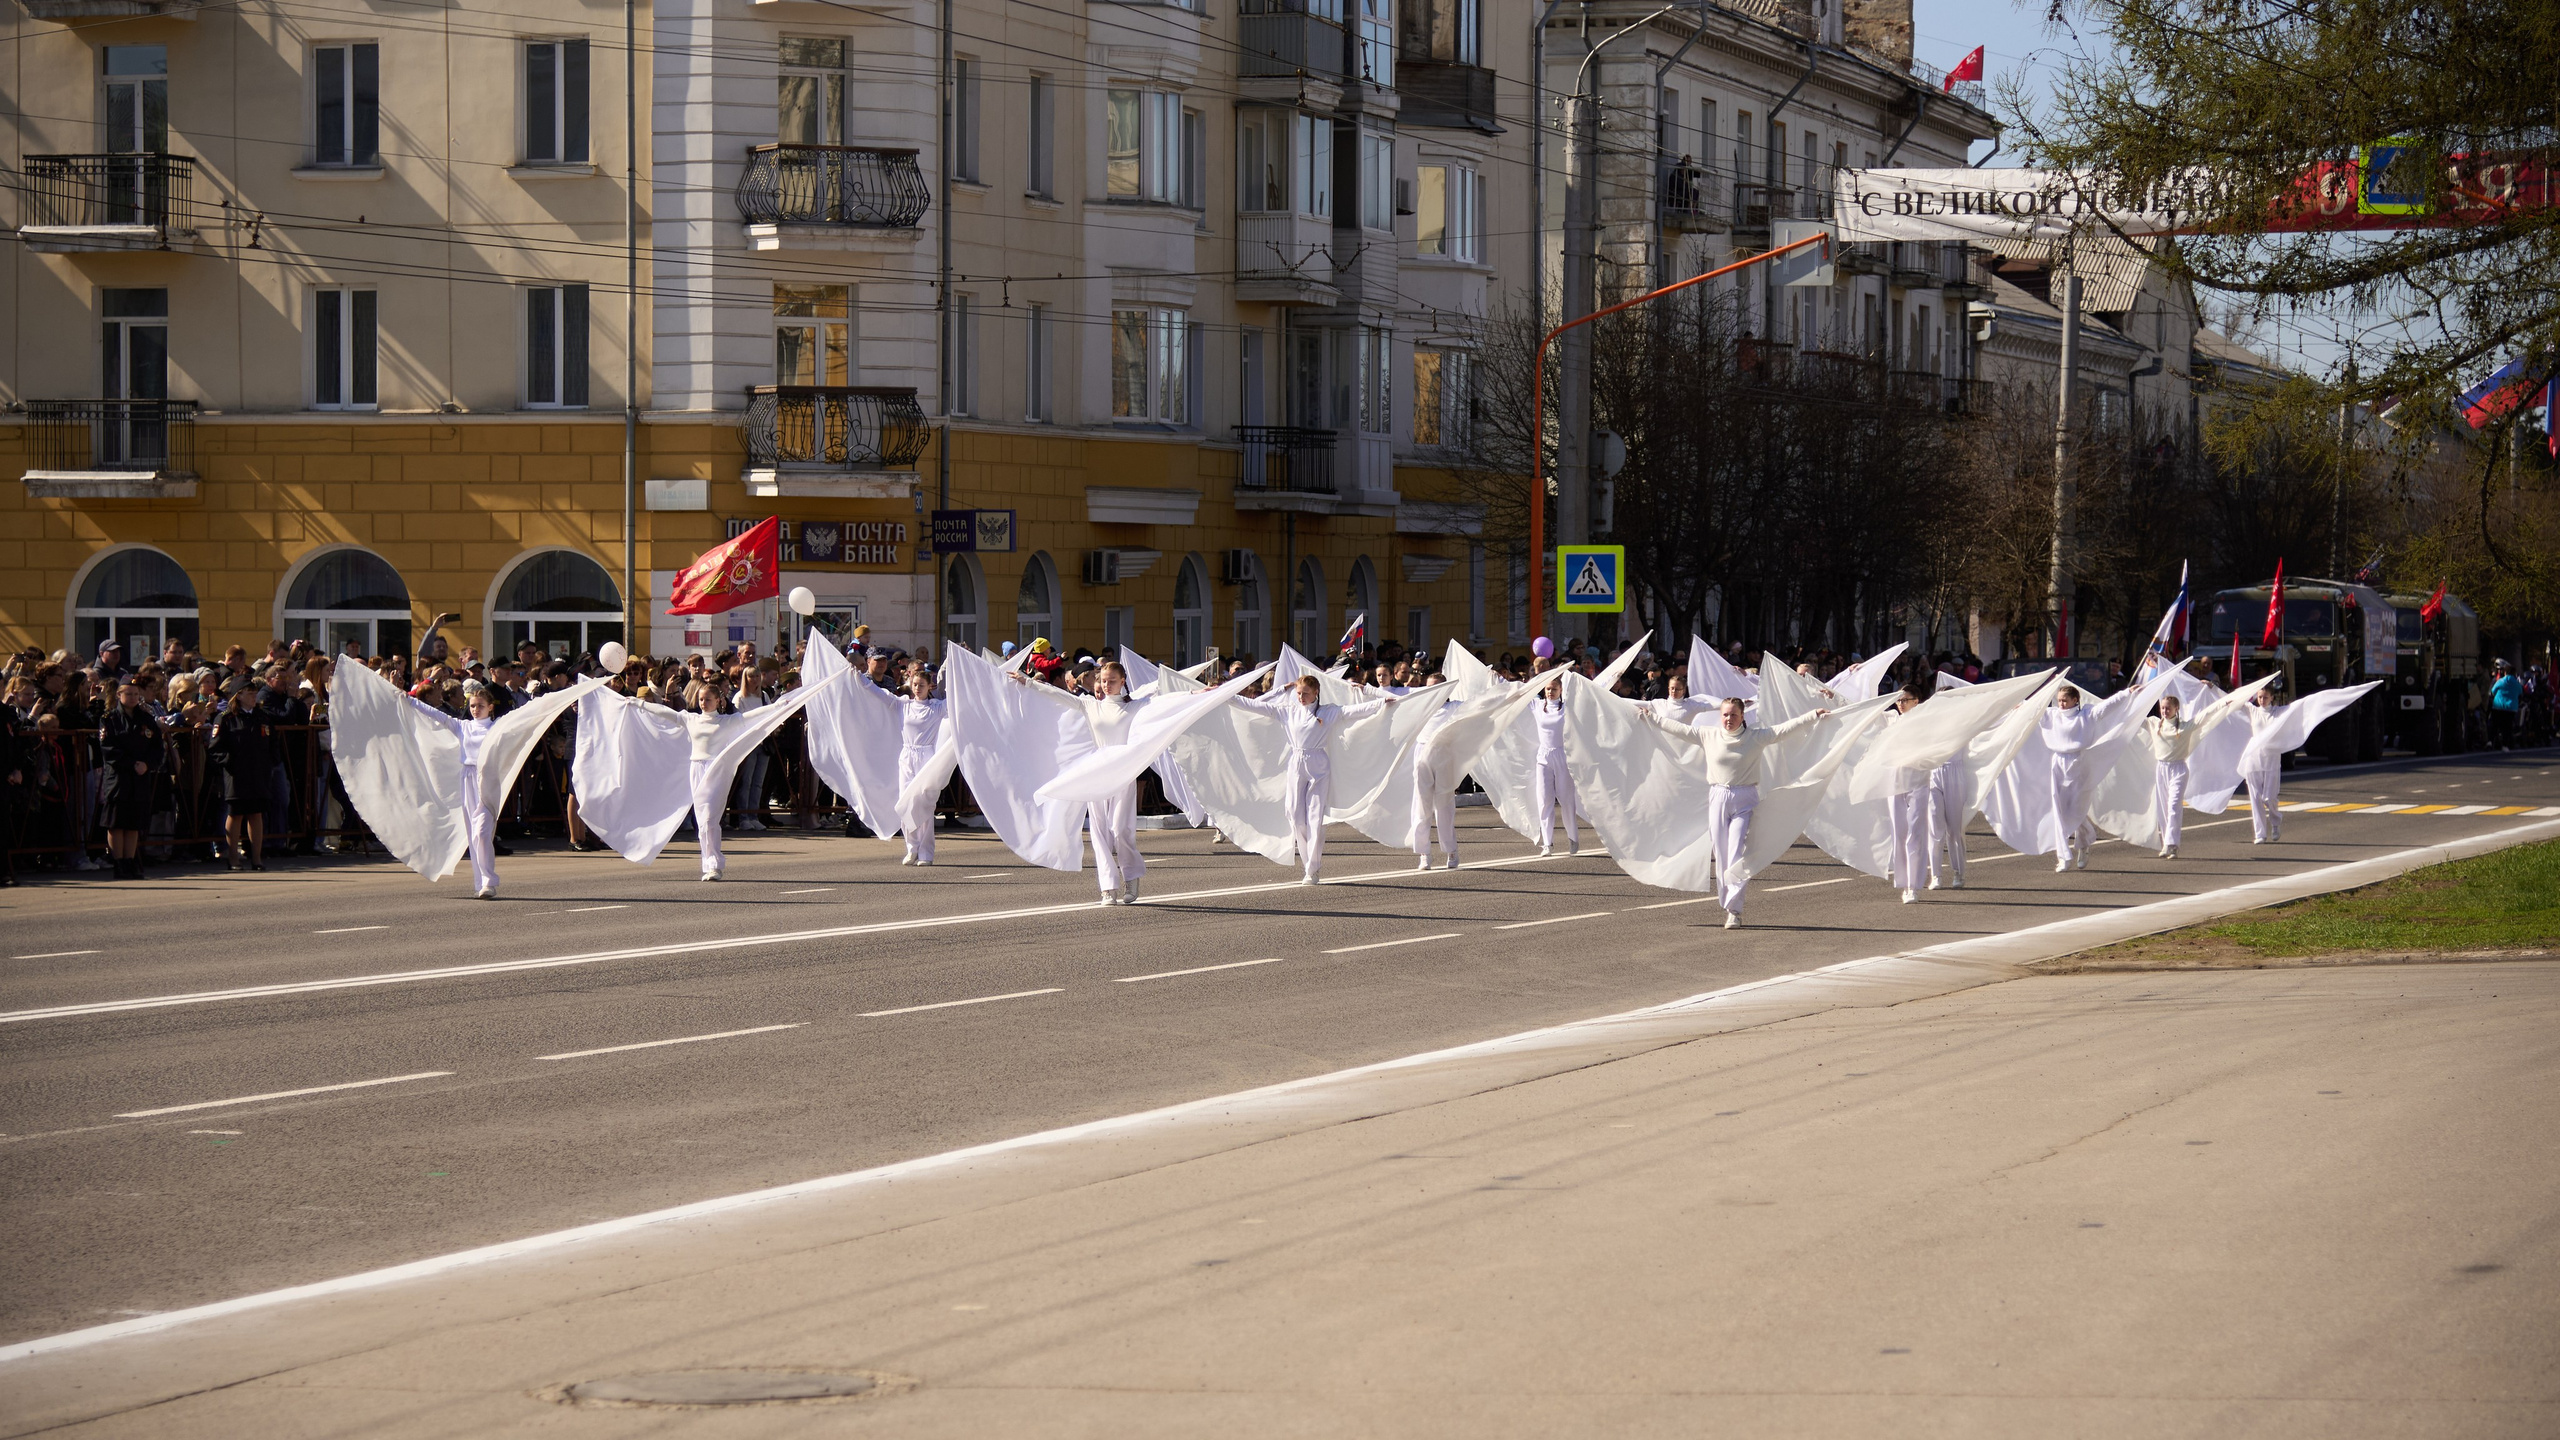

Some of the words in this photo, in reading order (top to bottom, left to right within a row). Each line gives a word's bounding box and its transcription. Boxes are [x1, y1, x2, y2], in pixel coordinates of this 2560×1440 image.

[2319, 171, 2348, 216] 9
[1861, 191, 1882, 216] С
[915, 495, 922, 509] 30
[727, 518, 791, 541] ПОА
[844, 522, 907, 542] ПОЧТА
[935, 519, 967, 530] ПОЧТА
[935, 533, 968, 543] РОССИИ
[844, 544, 898, 563] БАНК
